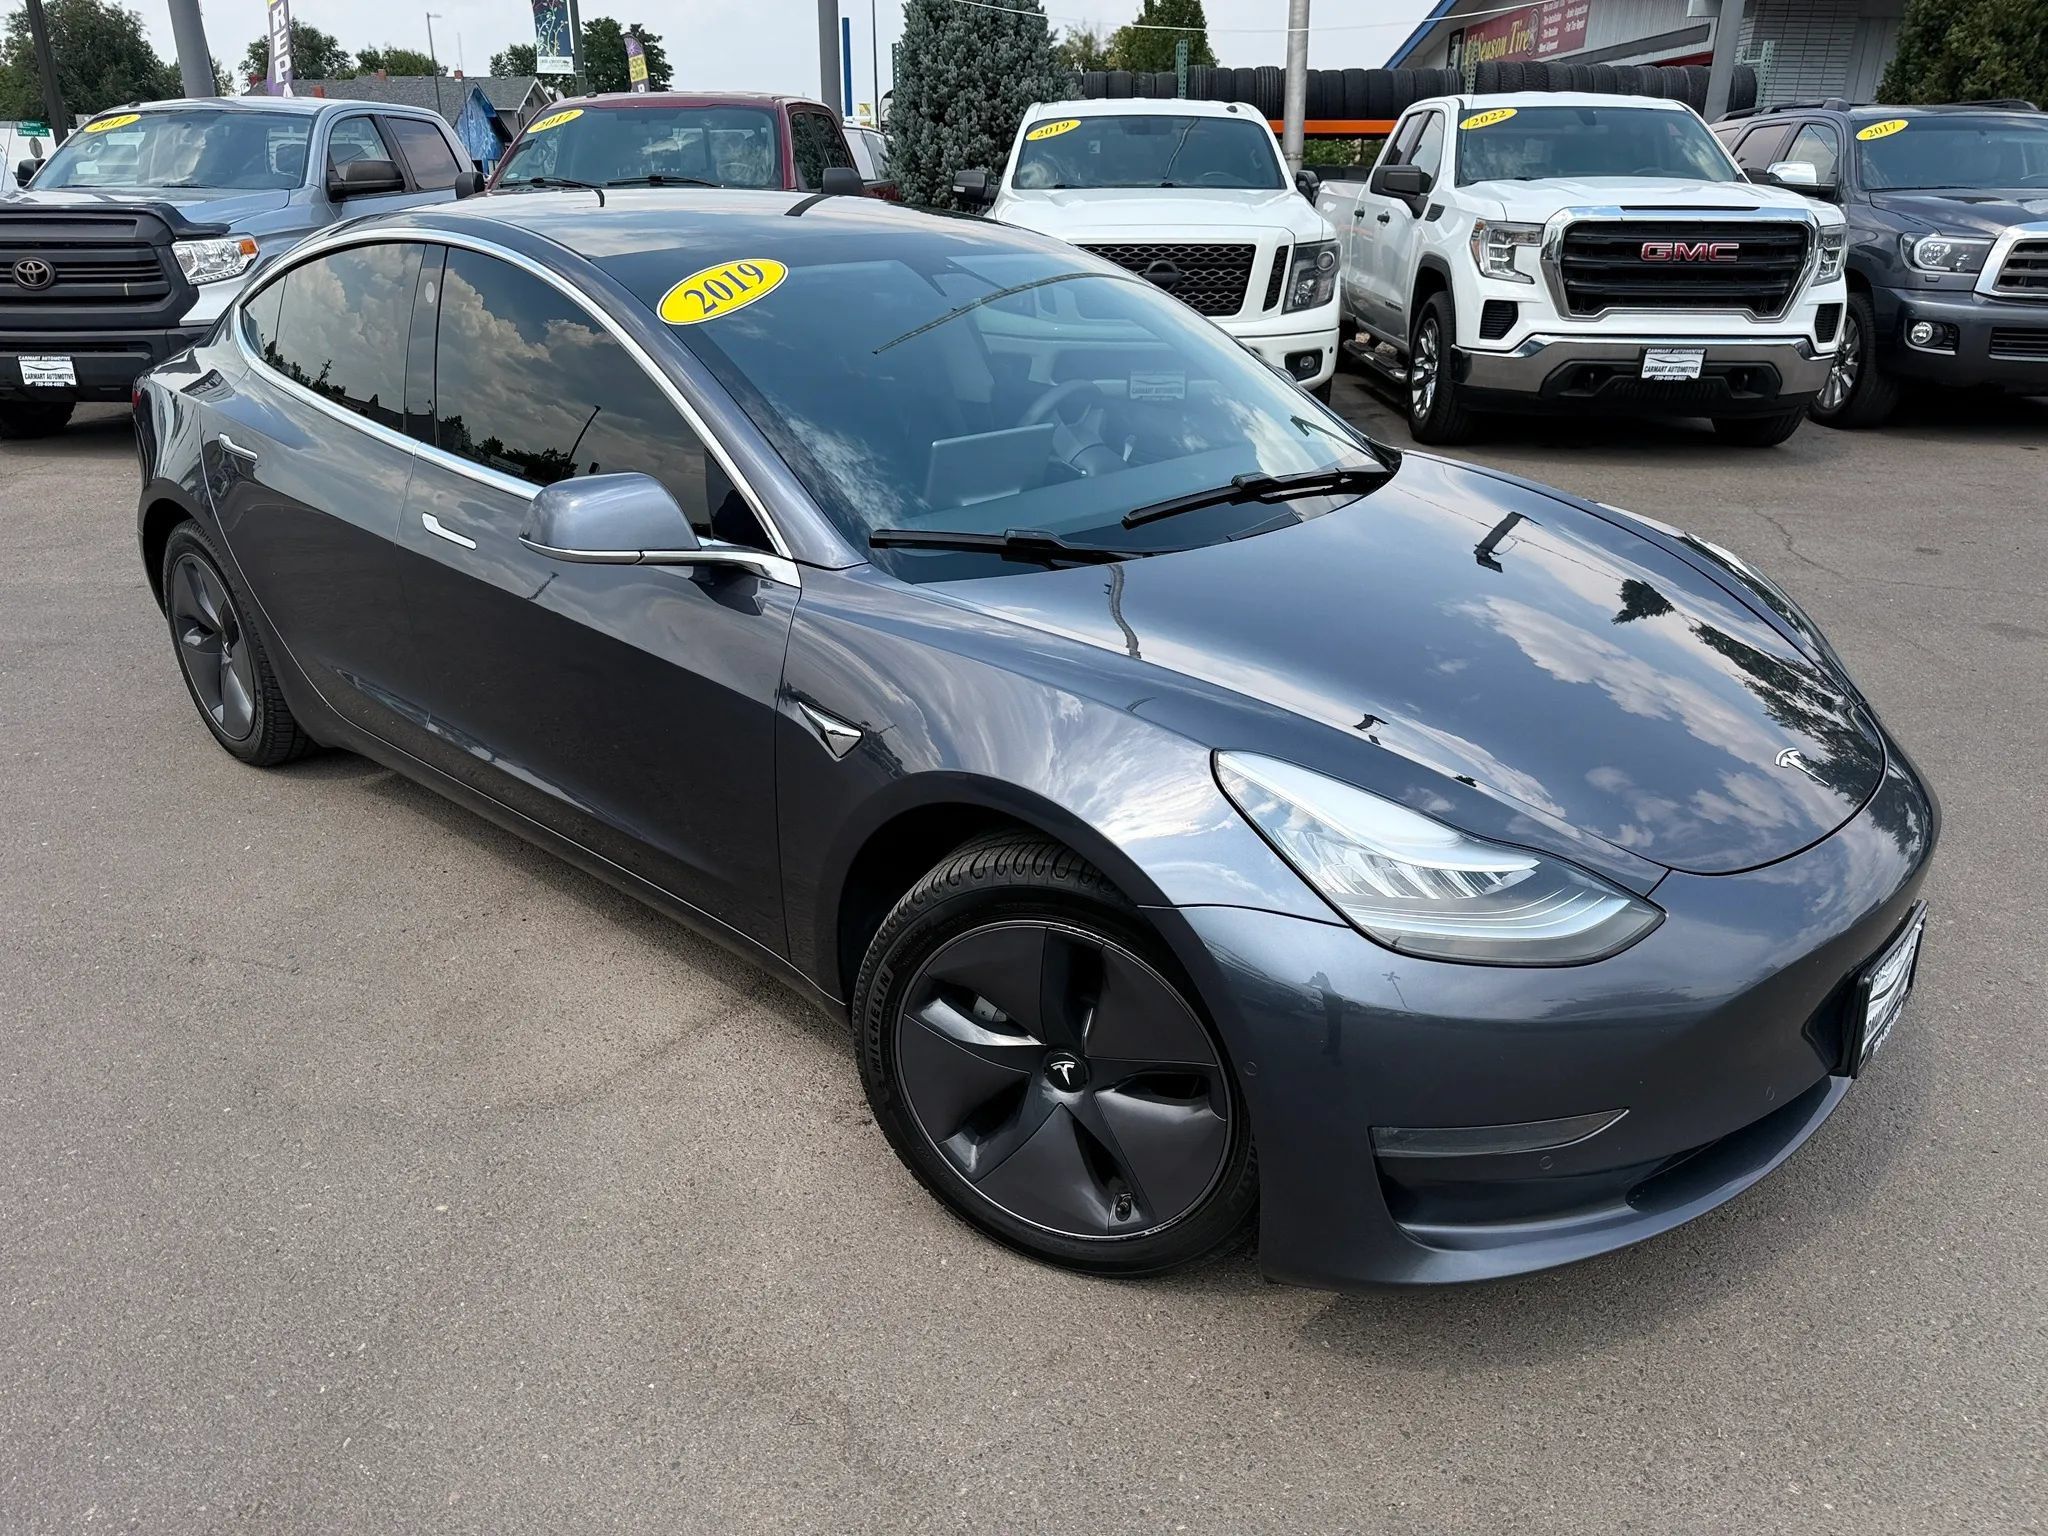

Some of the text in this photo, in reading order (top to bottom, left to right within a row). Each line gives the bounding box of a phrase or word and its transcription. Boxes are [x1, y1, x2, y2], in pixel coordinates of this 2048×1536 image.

[1508, 20, 1530, 54] Tire
[1471, 110, 1507, 126] 2022
[1037, 122, 1069, 137] 2019
[1867, 121, 1896, 137] 2017
[1641, 242, 1740, 261] GMC
[684, 263, 764, 315] 2019
[46, 373, 74, 381] AUTOMOTIVE
[1667, 366, 1699, 374] AUTOMOTIVE
[869, 971, 891, 1074] MICHELIN
